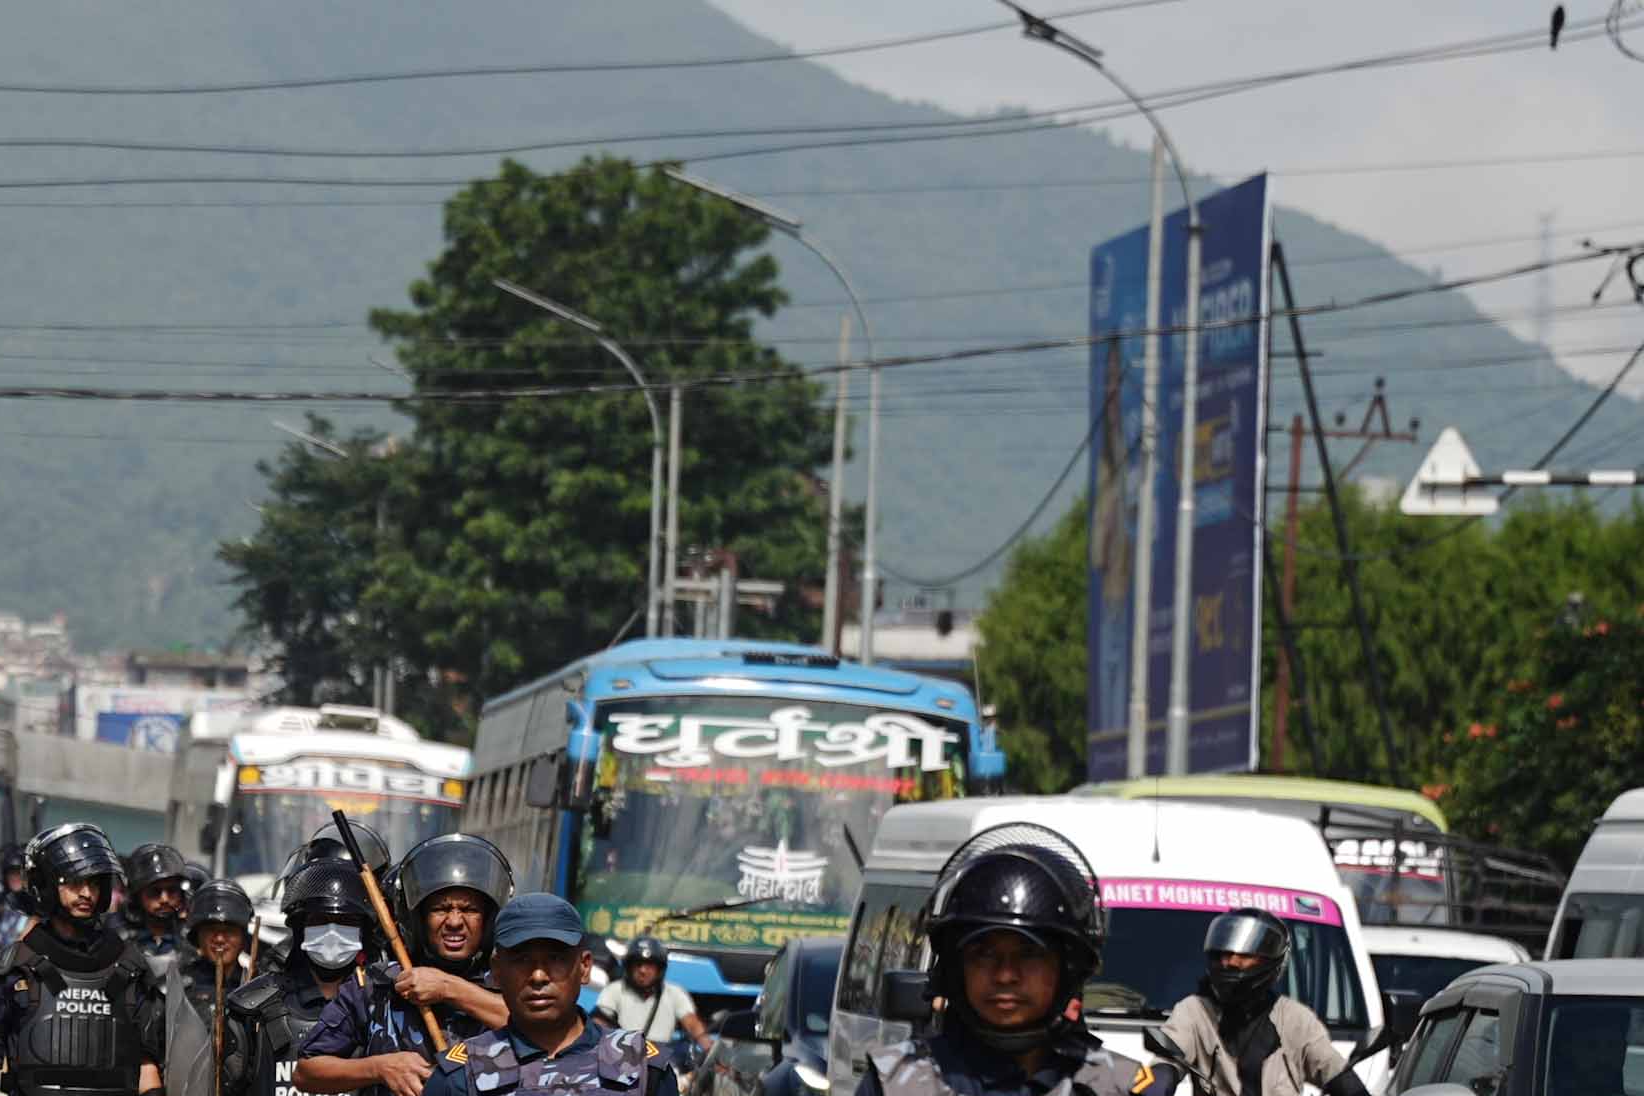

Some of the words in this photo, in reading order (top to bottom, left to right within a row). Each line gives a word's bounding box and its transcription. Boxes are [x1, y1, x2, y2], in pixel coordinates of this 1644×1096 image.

[737, 868, 821, 904] महाकाल
[1096, 883, 1153, 904] ANET
[1157, 885, 1288, 913] MONTESSORI
[59, 988, 108, 1002] NEPAL
[56, 1001, 112, 1015] POLICE
